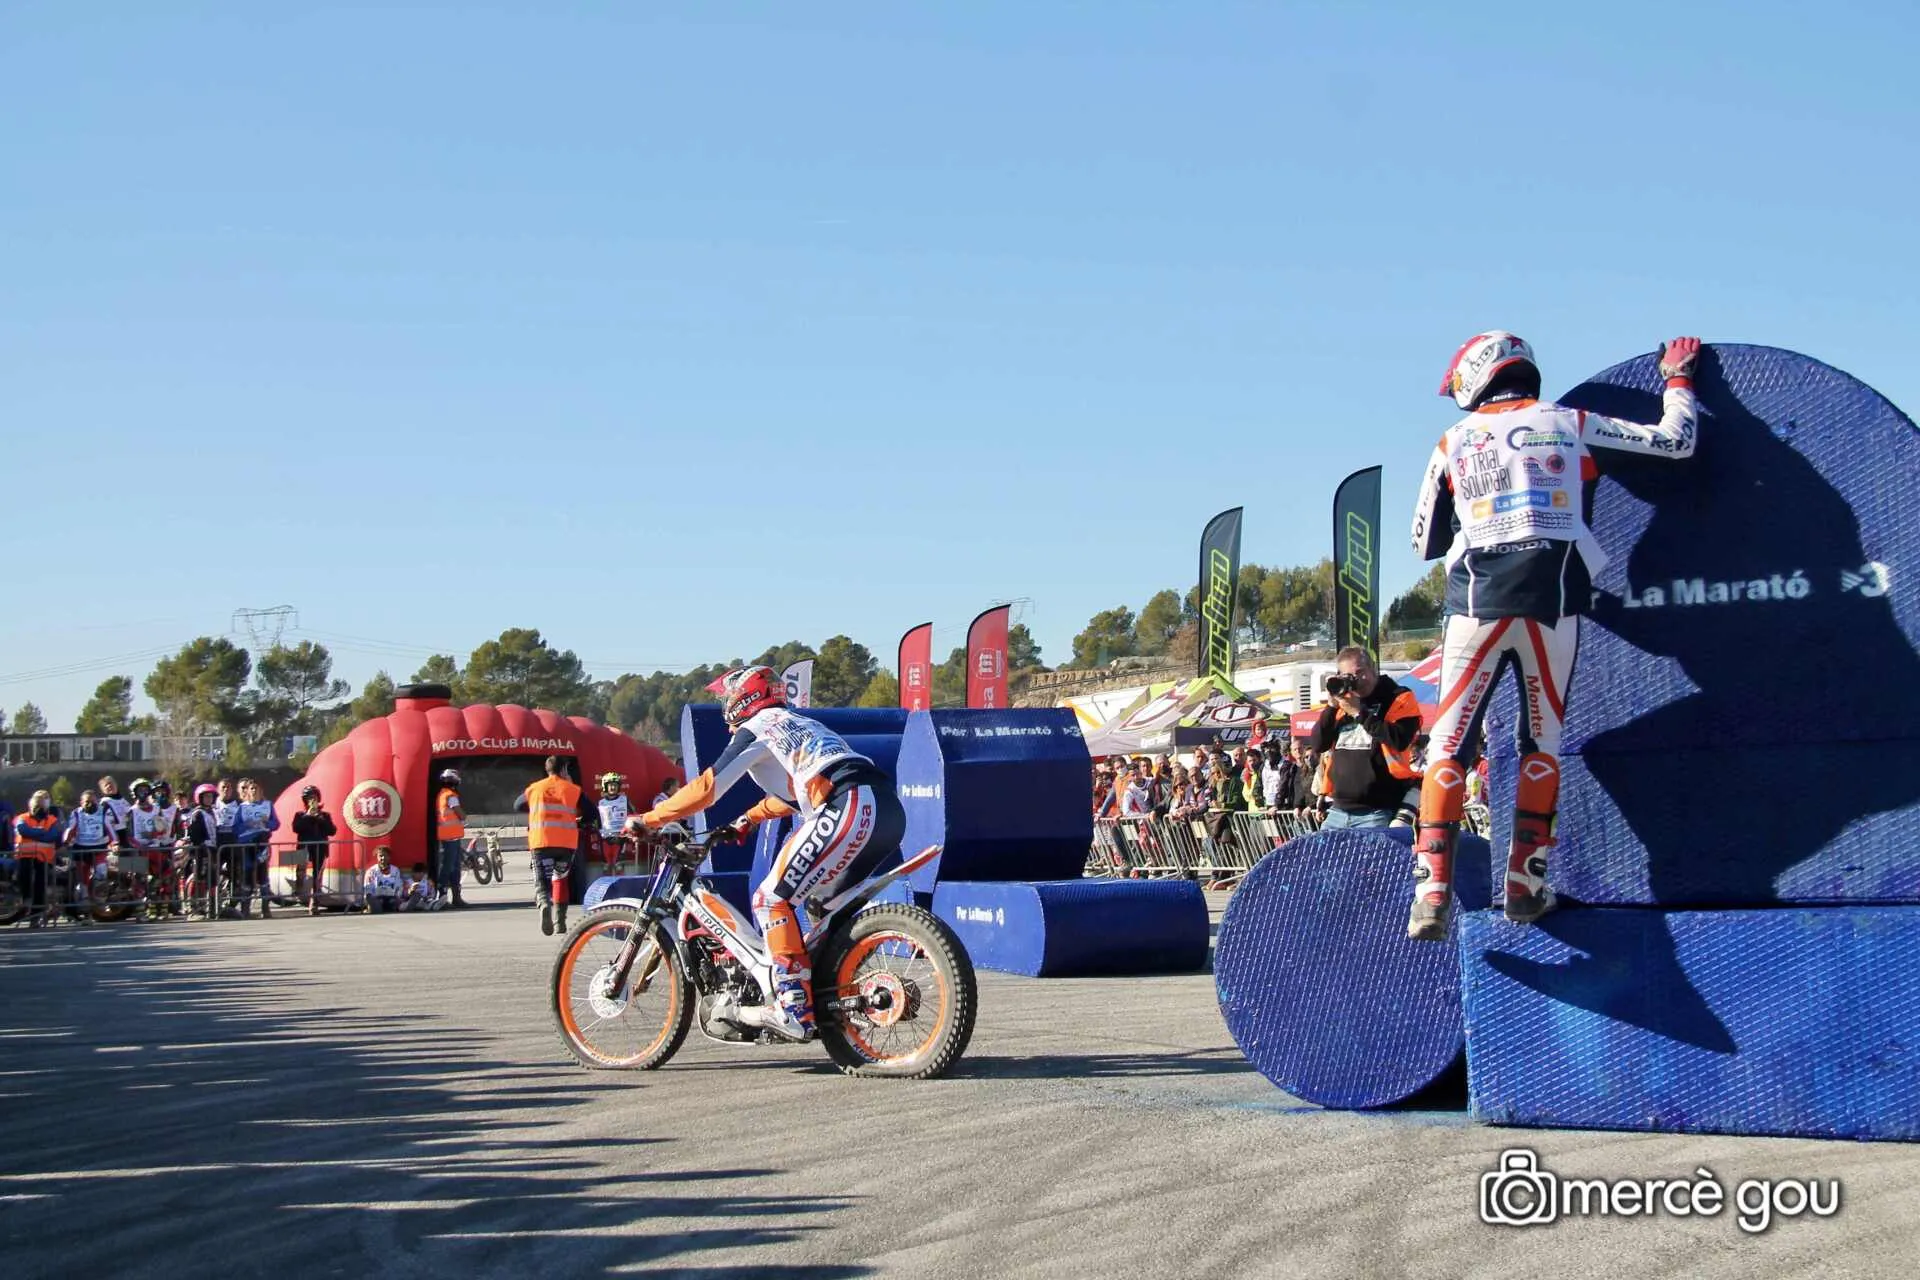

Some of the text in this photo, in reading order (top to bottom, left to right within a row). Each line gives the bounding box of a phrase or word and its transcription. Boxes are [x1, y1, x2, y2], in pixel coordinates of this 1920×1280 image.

[1482, 539, 1552, 554] HONDA
[1623, 584, 1665, 608] La
[1671, 569, 1810, 604] Marató
[432, 737, 575, 753] MOTO CLUB IMPALA
[783, 807, 841, 889] REPSOL
[820, 804, 872, 885] Montesa
